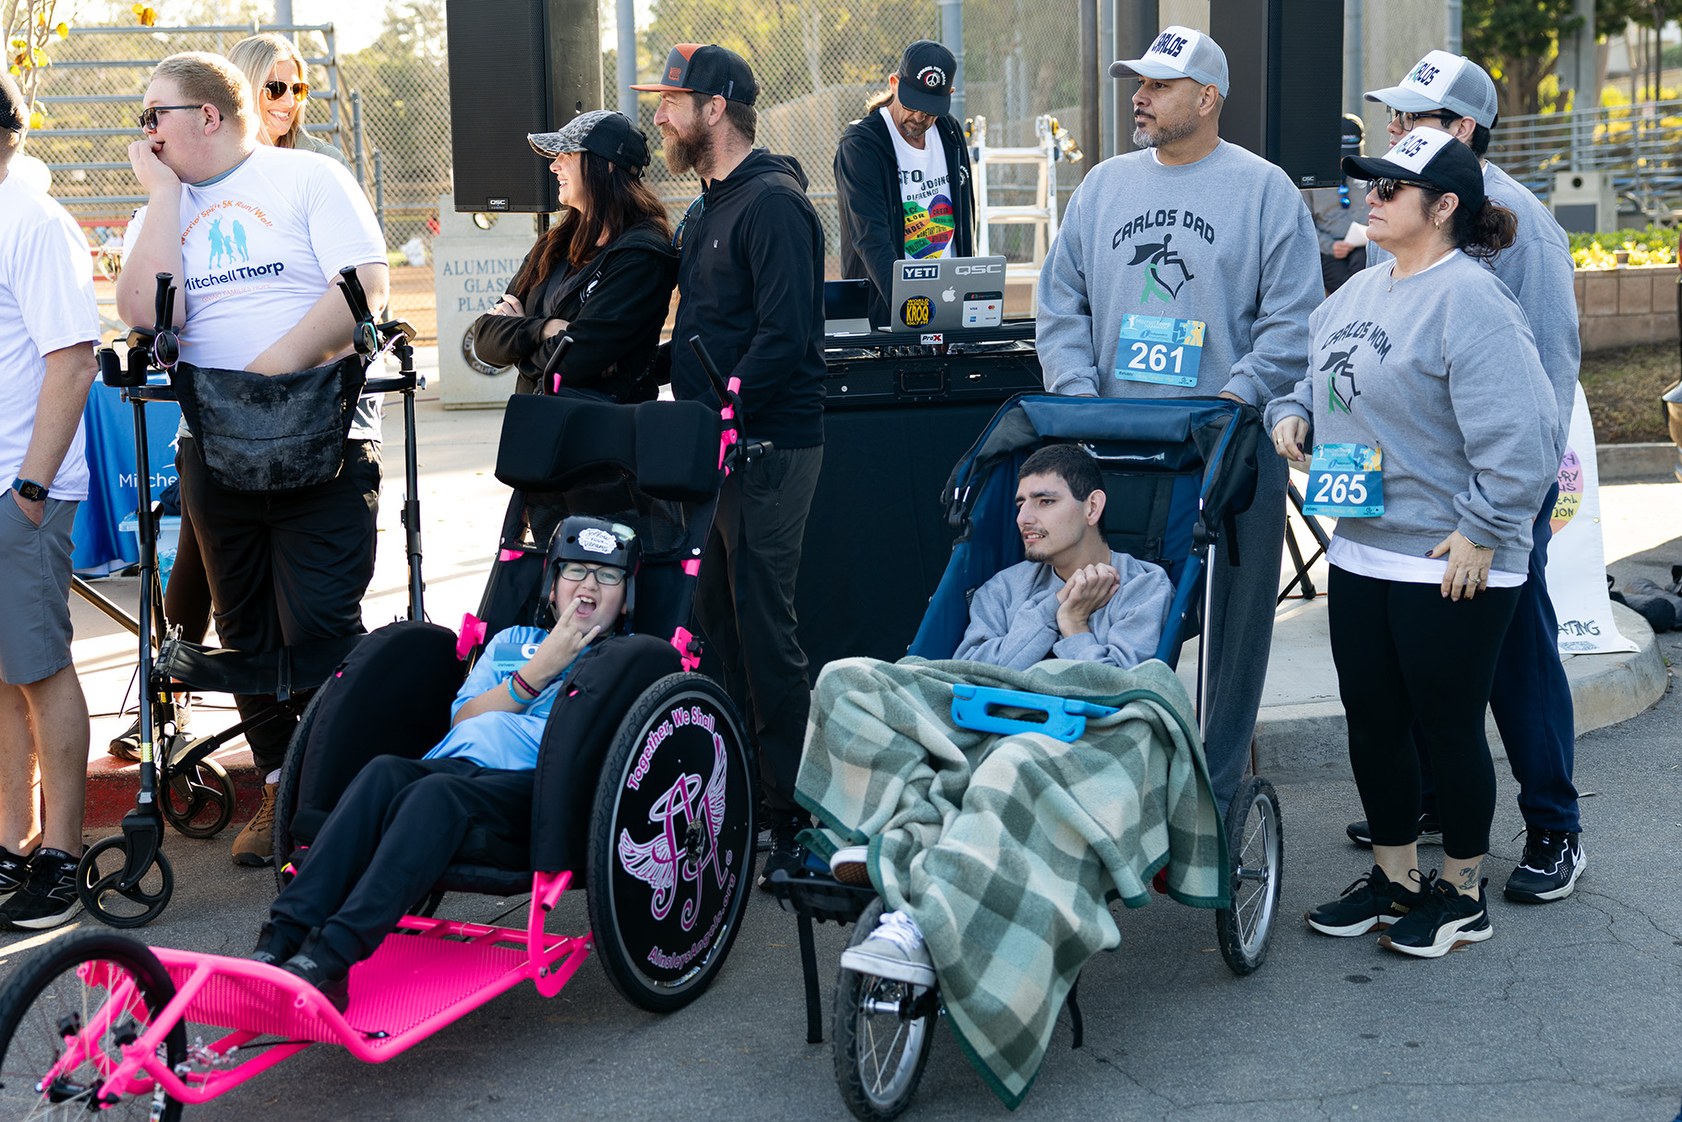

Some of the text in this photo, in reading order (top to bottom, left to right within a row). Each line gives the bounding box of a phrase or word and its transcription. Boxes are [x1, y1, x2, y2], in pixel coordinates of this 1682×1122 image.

[1151, 33, 1188, 57] CARLOS
[222, 200, 234, 209] 5K
[904, 206, 918, 217] ACE
[905, 213, 925, 222] LOR
[904, 221, 925, 237] NDER
[1112, 209, 1215, 250] CARLOS DAD
[443, 258, 525, 276] ALUMINU
[904, 267, 936, 278] YETI
[955, 264, 1002, 276] QSC
[907, 304, 929, 321] KROQ
[1321, 320, 1392, 365] CARLOS MOM
[1128, 342, 1184, 373] 261
[119, 473, 178, 488] Miche
[1313, 473, 1368, 504] 265
[1558, 619, 1601, 636] ATING
[627, 706, 716, 791] Together, We Shall
[647, 871, 736, 970] AinsleysAngels.org
